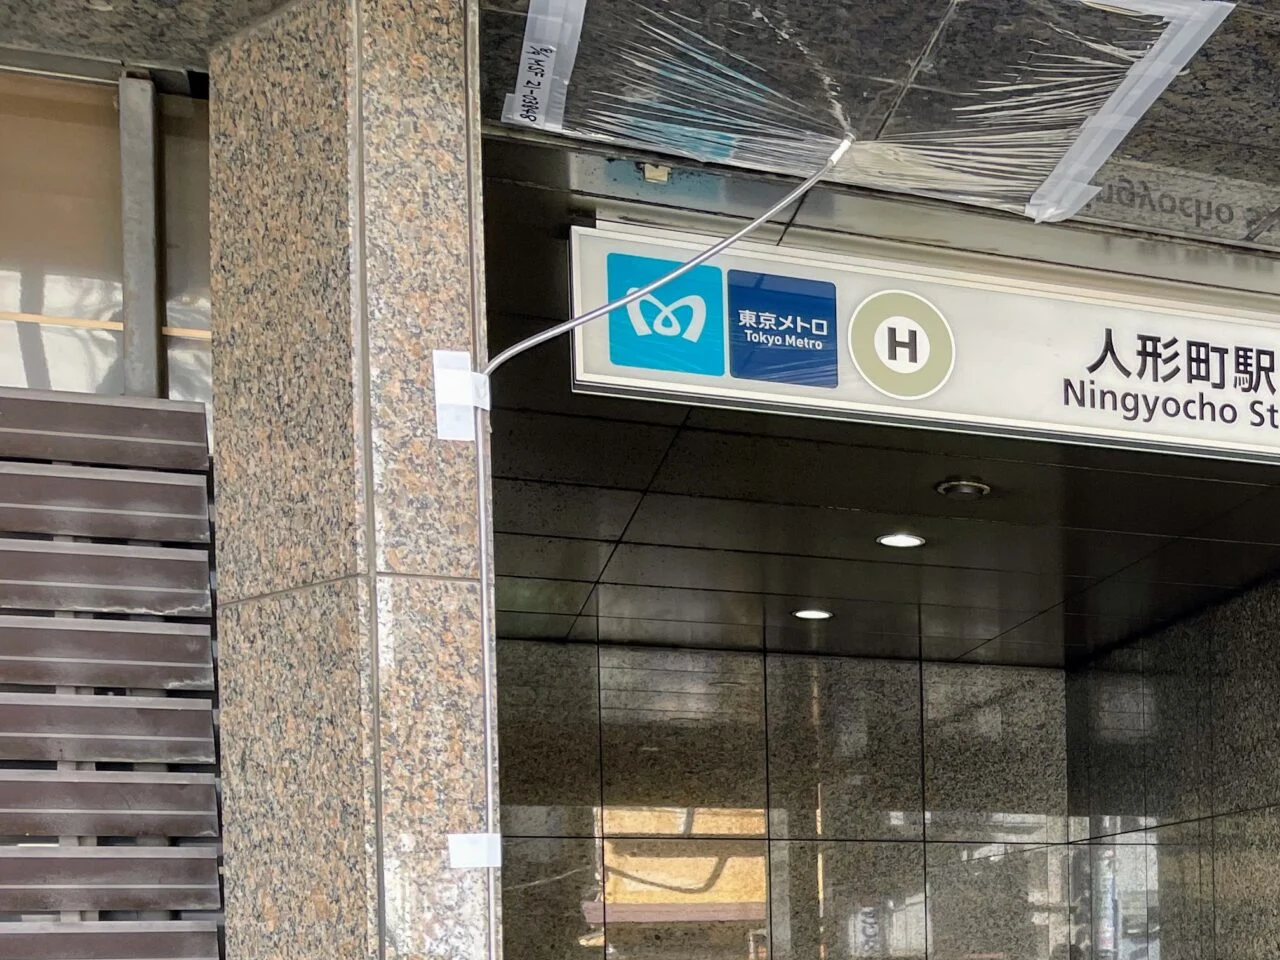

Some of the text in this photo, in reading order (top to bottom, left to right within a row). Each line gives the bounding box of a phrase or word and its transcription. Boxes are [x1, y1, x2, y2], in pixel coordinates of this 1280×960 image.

[738, 309, 829, 337] 東京メトロ
[744, 329, 823, 351] Tokyo Metro
[887, 327, 918, 364] H
[1086, 328, 1277, 396] 人形町駅
[1063, 378, 1238, 425] Ningyocho
